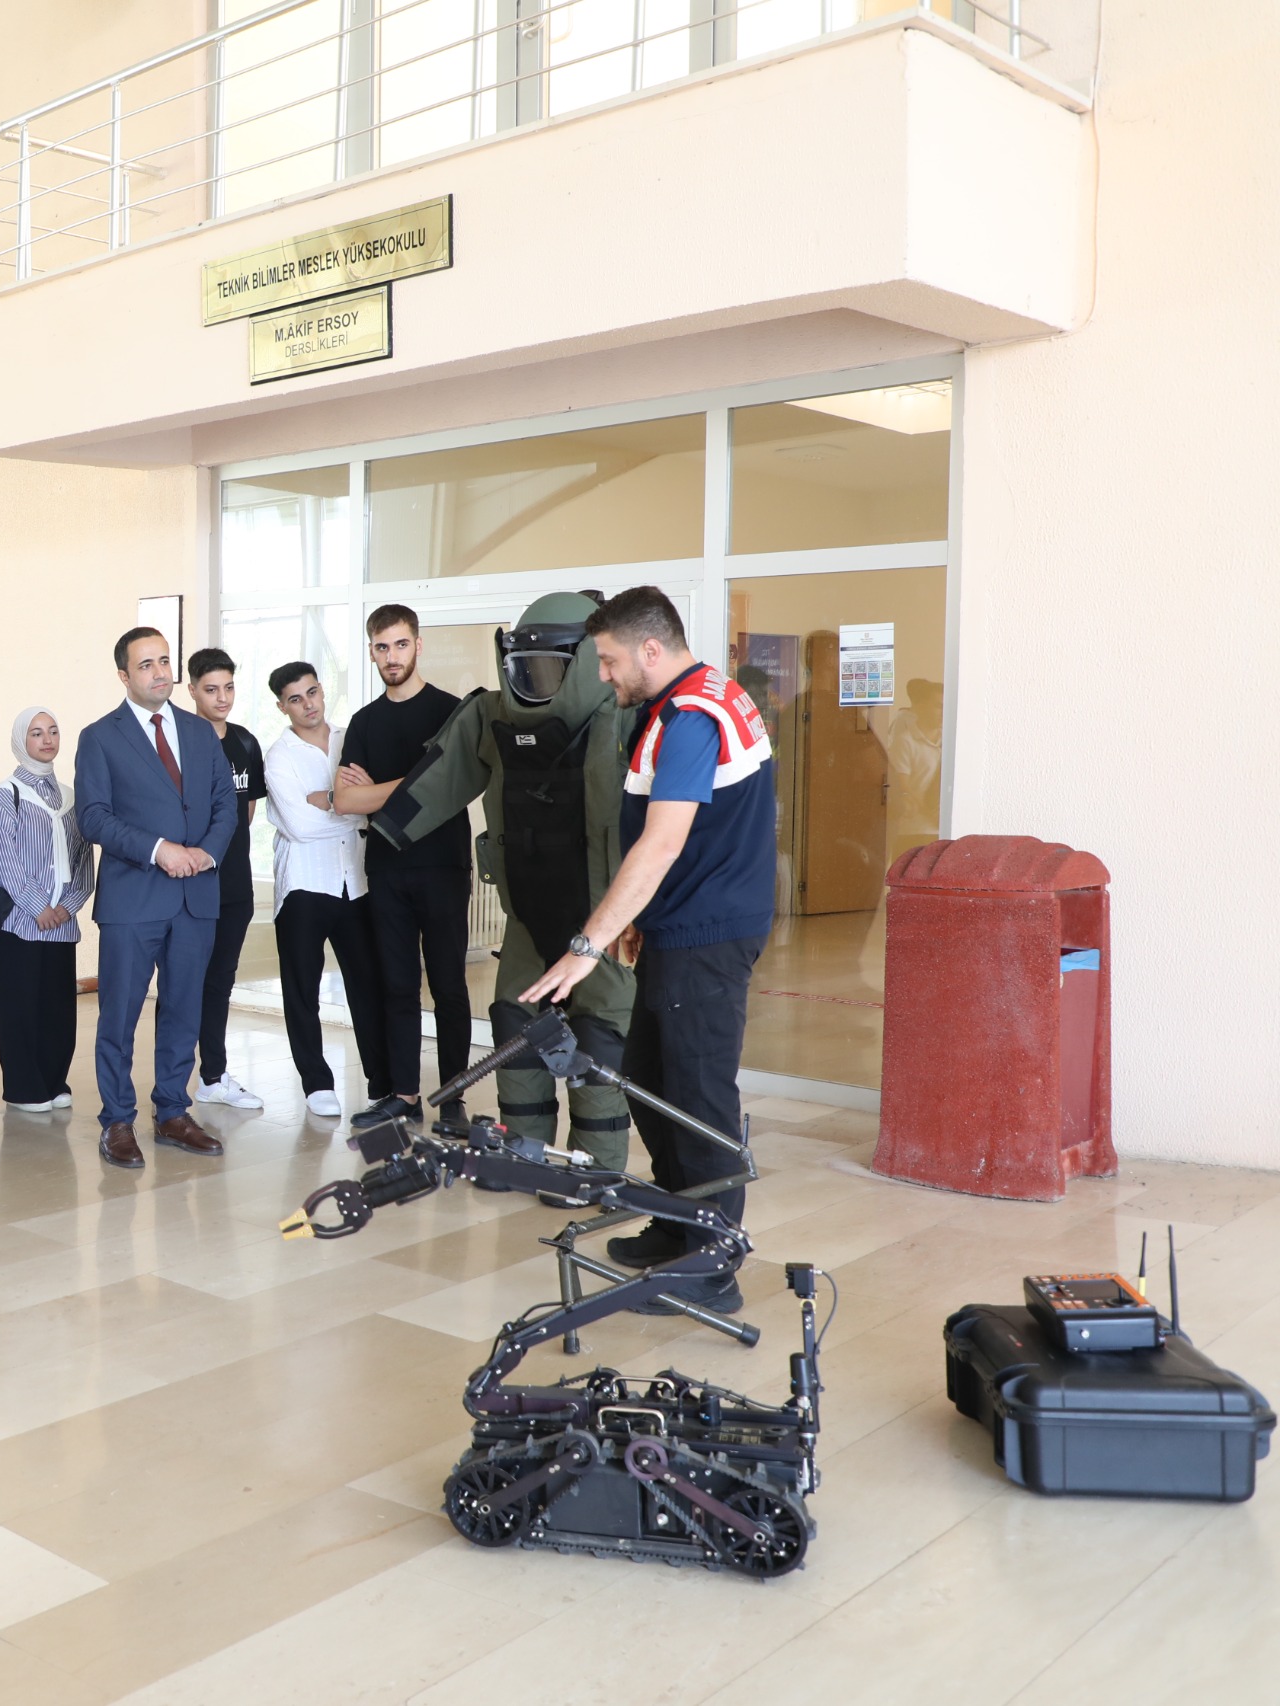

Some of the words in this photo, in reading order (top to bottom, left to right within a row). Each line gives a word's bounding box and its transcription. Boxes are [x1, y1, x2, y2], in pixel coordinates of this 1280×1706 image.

[217, 275, 250, 299] TEKNİK
[252, 262, 296, 290] BİLİMLER
[298, 250, 340, 277] MESLEK
[342, 228, 426, 266] YÜKSEKOKULU
[274, 321, 313, 343] M.ÂKİF
[317, 311, 359, 334] ERSOY
[284, 331, 348, 358] DERSLİKLERİ
